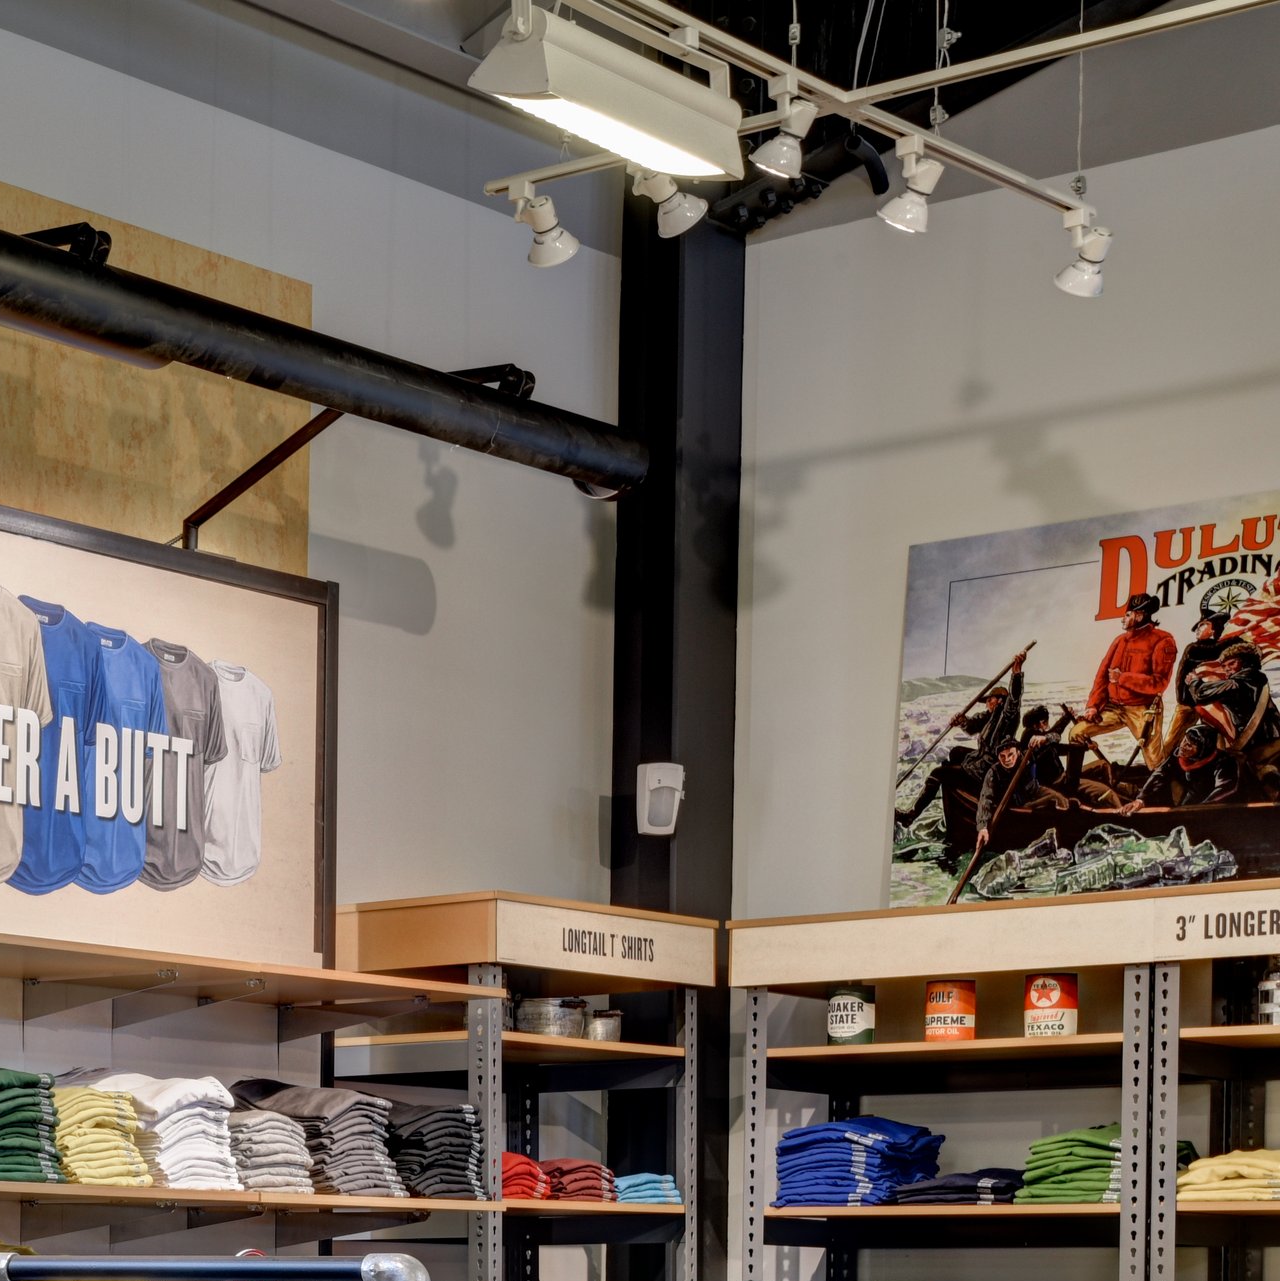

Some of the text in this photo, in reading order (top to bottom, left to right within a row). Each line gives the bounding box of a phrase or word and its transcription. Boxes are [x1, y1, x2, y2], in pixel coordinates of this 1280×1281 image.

[1095, 515, 1280, 621] DULU
[1156, 554, 1280, 608] TRADIN
[55, 716, 80, 814] A
[95, 726, 194, 830] BUTT
[1203, 908, 1280, 940] LONGER
[562, 927, 607, 957] LONGTAIL
[621, 935, 654, 962] SHIRTS
[828, 1002, 864, 1014] UAKER
[929, 991, 954, 1004] GULF
[830, 1013, 857, 1025] STATE
[1027, 1023, 1065, 1031] TEXACO
